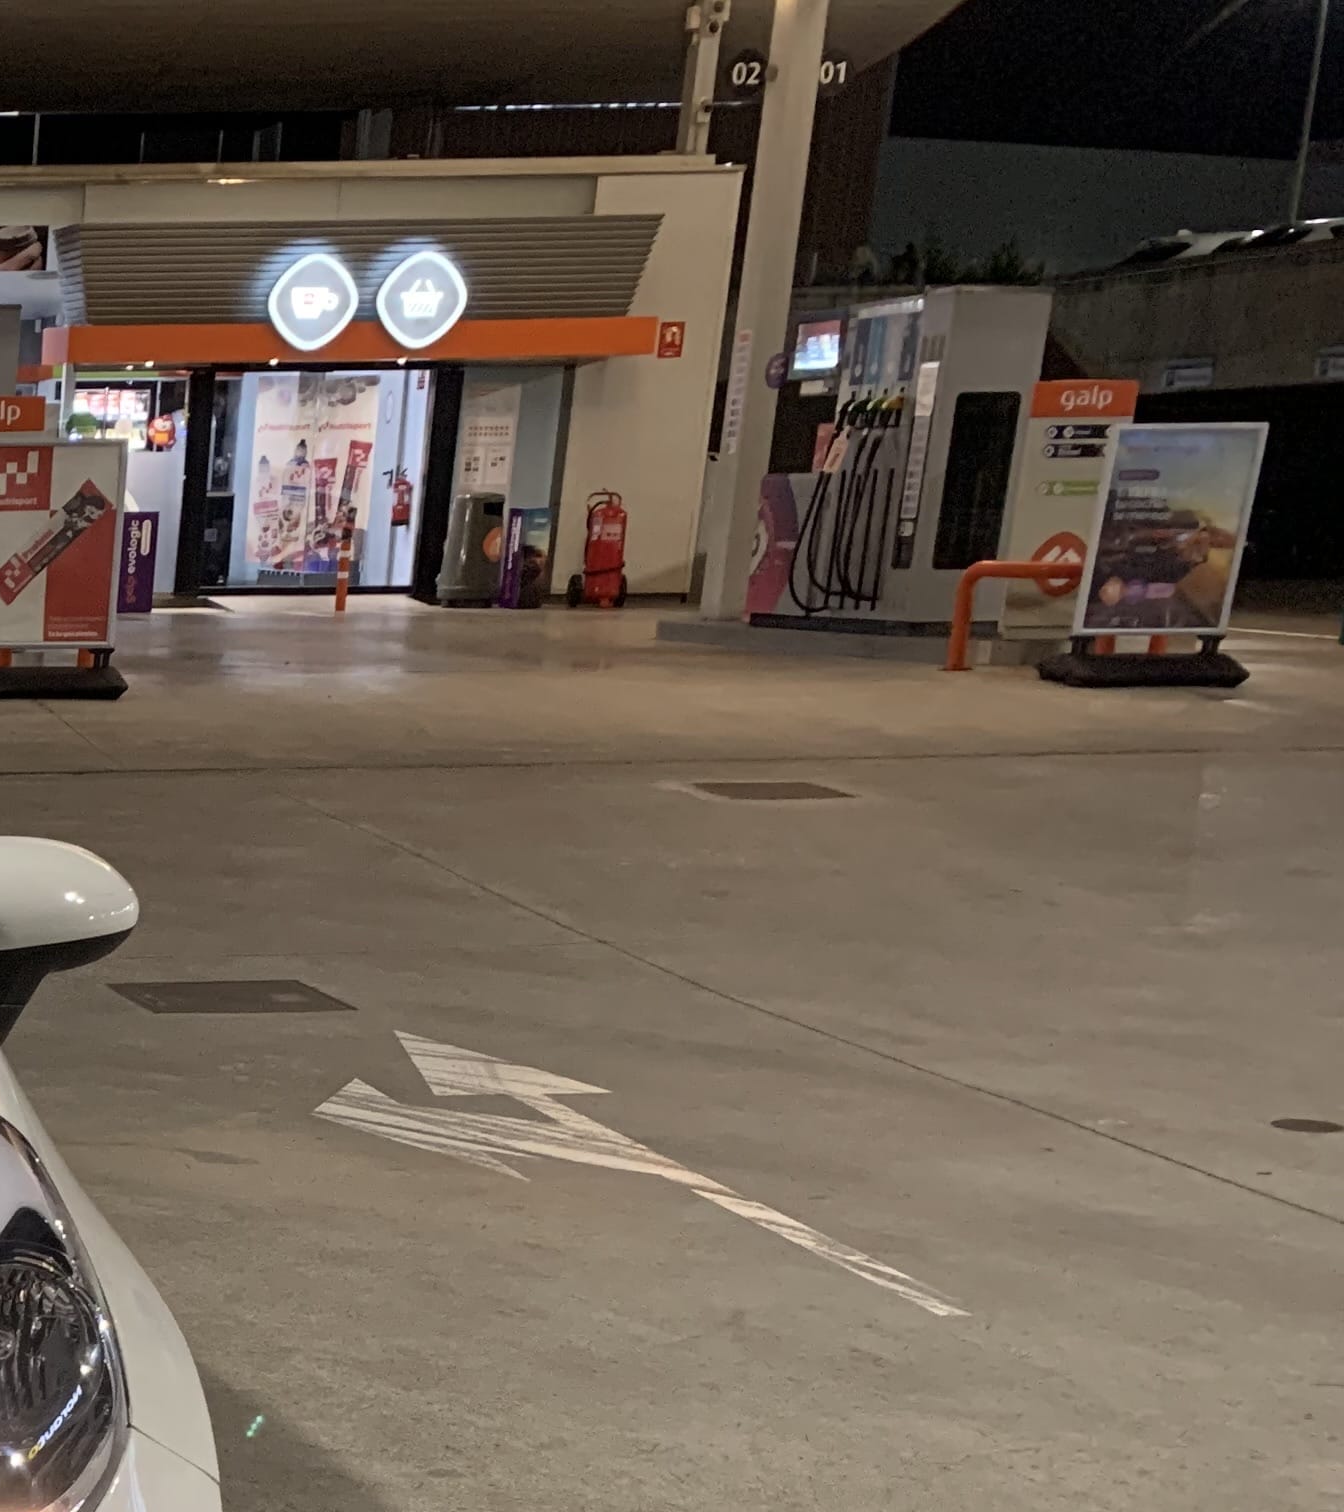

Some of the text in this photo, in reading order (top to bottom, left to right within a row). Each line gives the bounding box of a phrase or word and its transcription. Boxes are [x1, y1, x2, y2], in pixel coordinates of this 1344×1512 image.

[732, 61, 762, 86] 02
[819, 60, 848, 85] 01
[1060, 384, 1114, 412] galp
[127, 519, 141, 575] evologic
